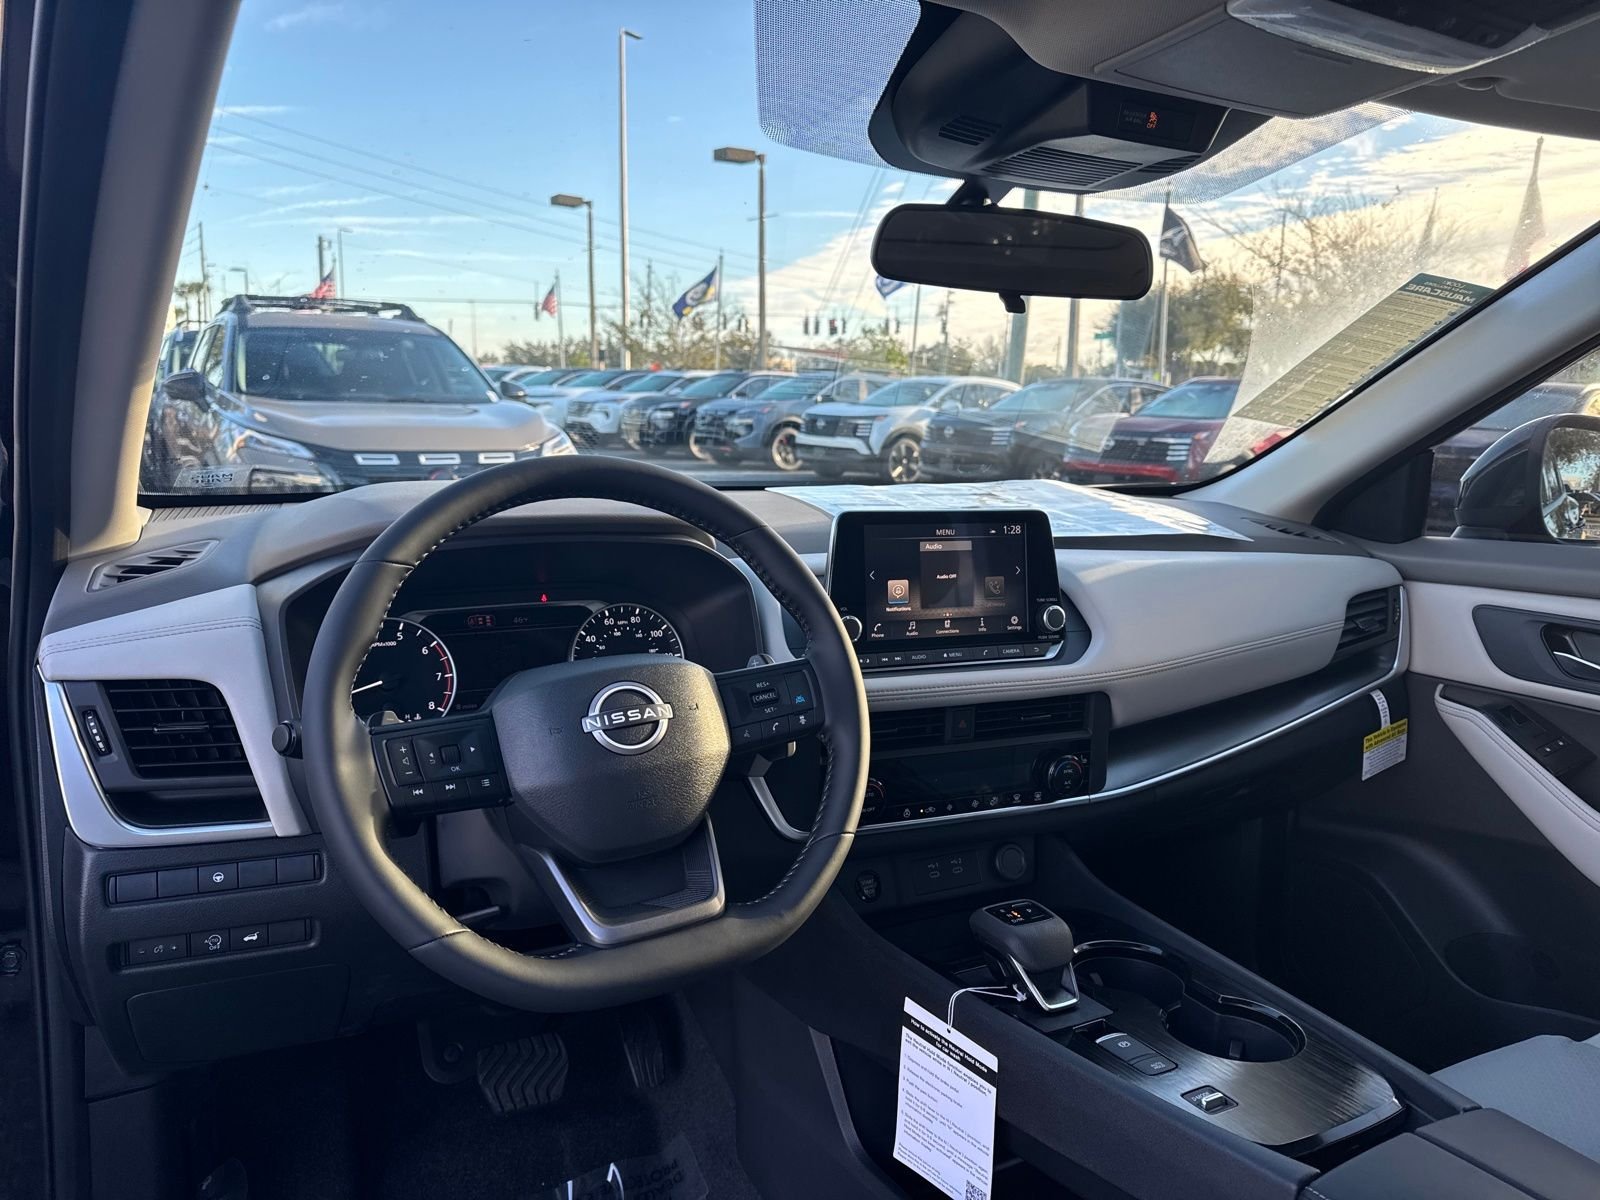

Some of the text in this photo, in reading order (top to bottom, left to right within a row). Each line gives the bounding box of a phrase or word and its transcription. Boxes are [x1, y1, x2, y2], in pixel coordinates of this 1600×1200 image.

[1003, 525, 1021, 534] 1:28
[756, 692, 776, 701] CANCEL
[586, 706, 671, 729] NISSAN
[964, 1054, 974, 1064] Hold
